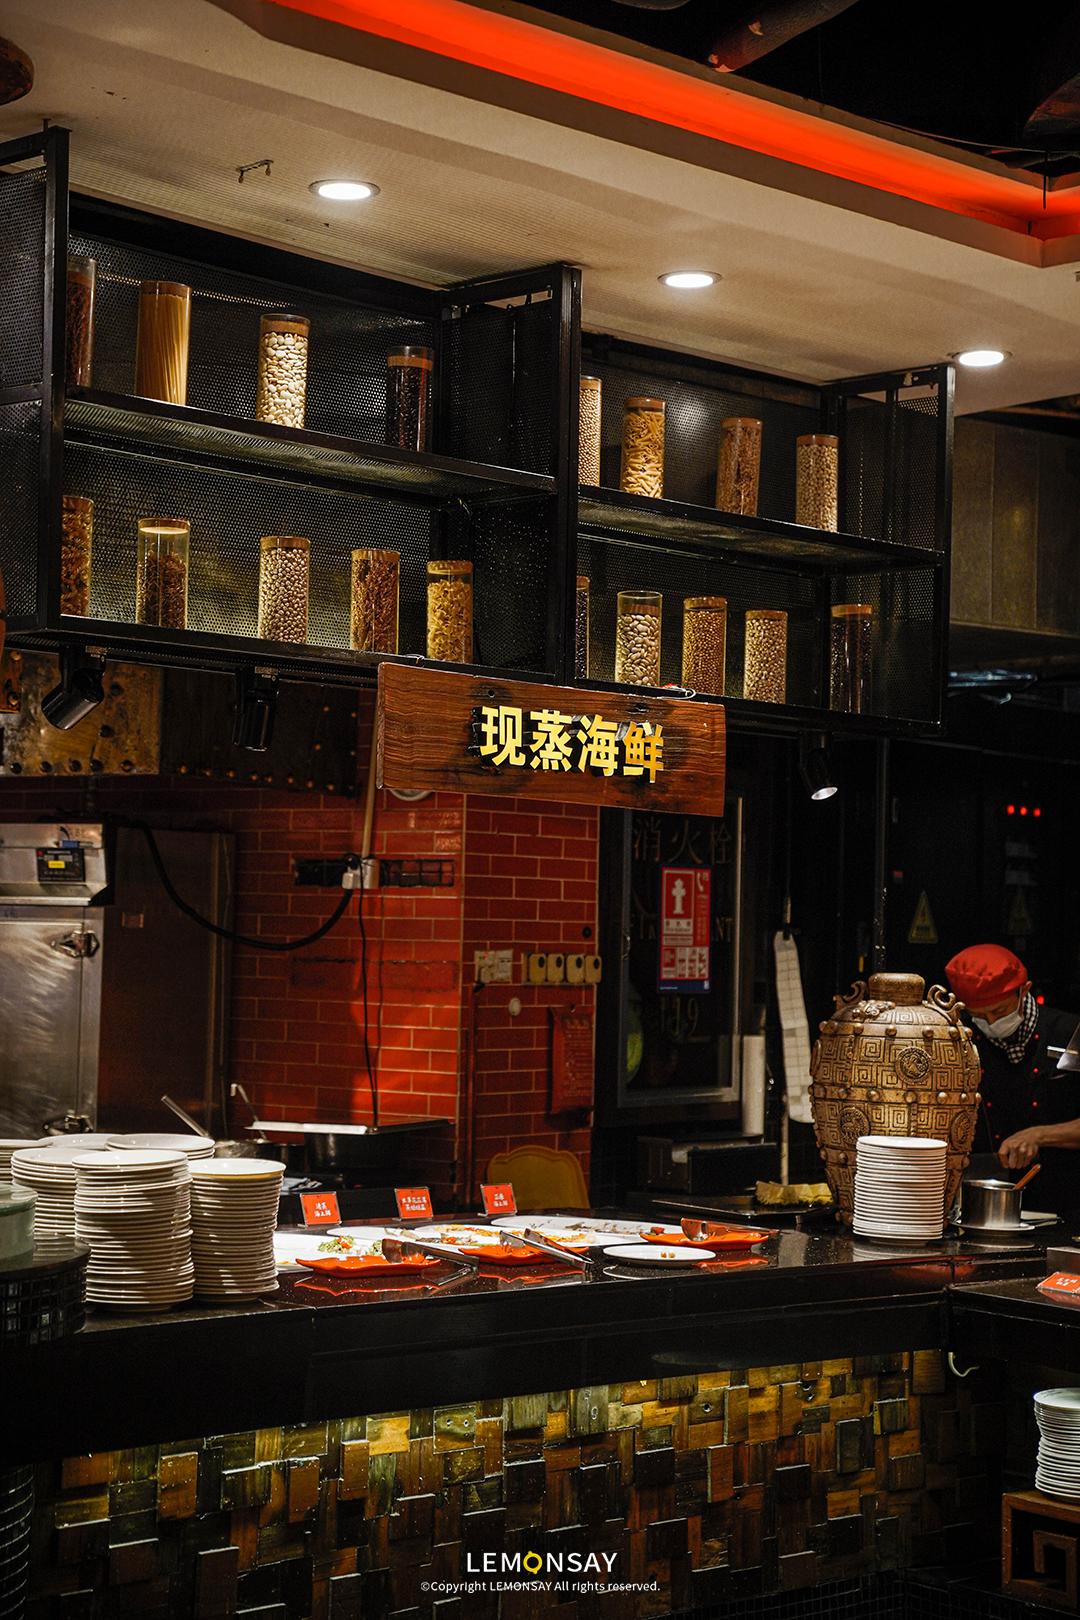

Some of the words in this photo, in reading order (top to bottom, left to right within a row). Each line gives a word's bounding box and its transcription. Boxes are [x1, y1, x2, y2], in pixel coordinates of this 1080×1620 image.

[480, 705, 664, 783] 现蒸海鲜
[634, 815, 732, 864] 消火栓
